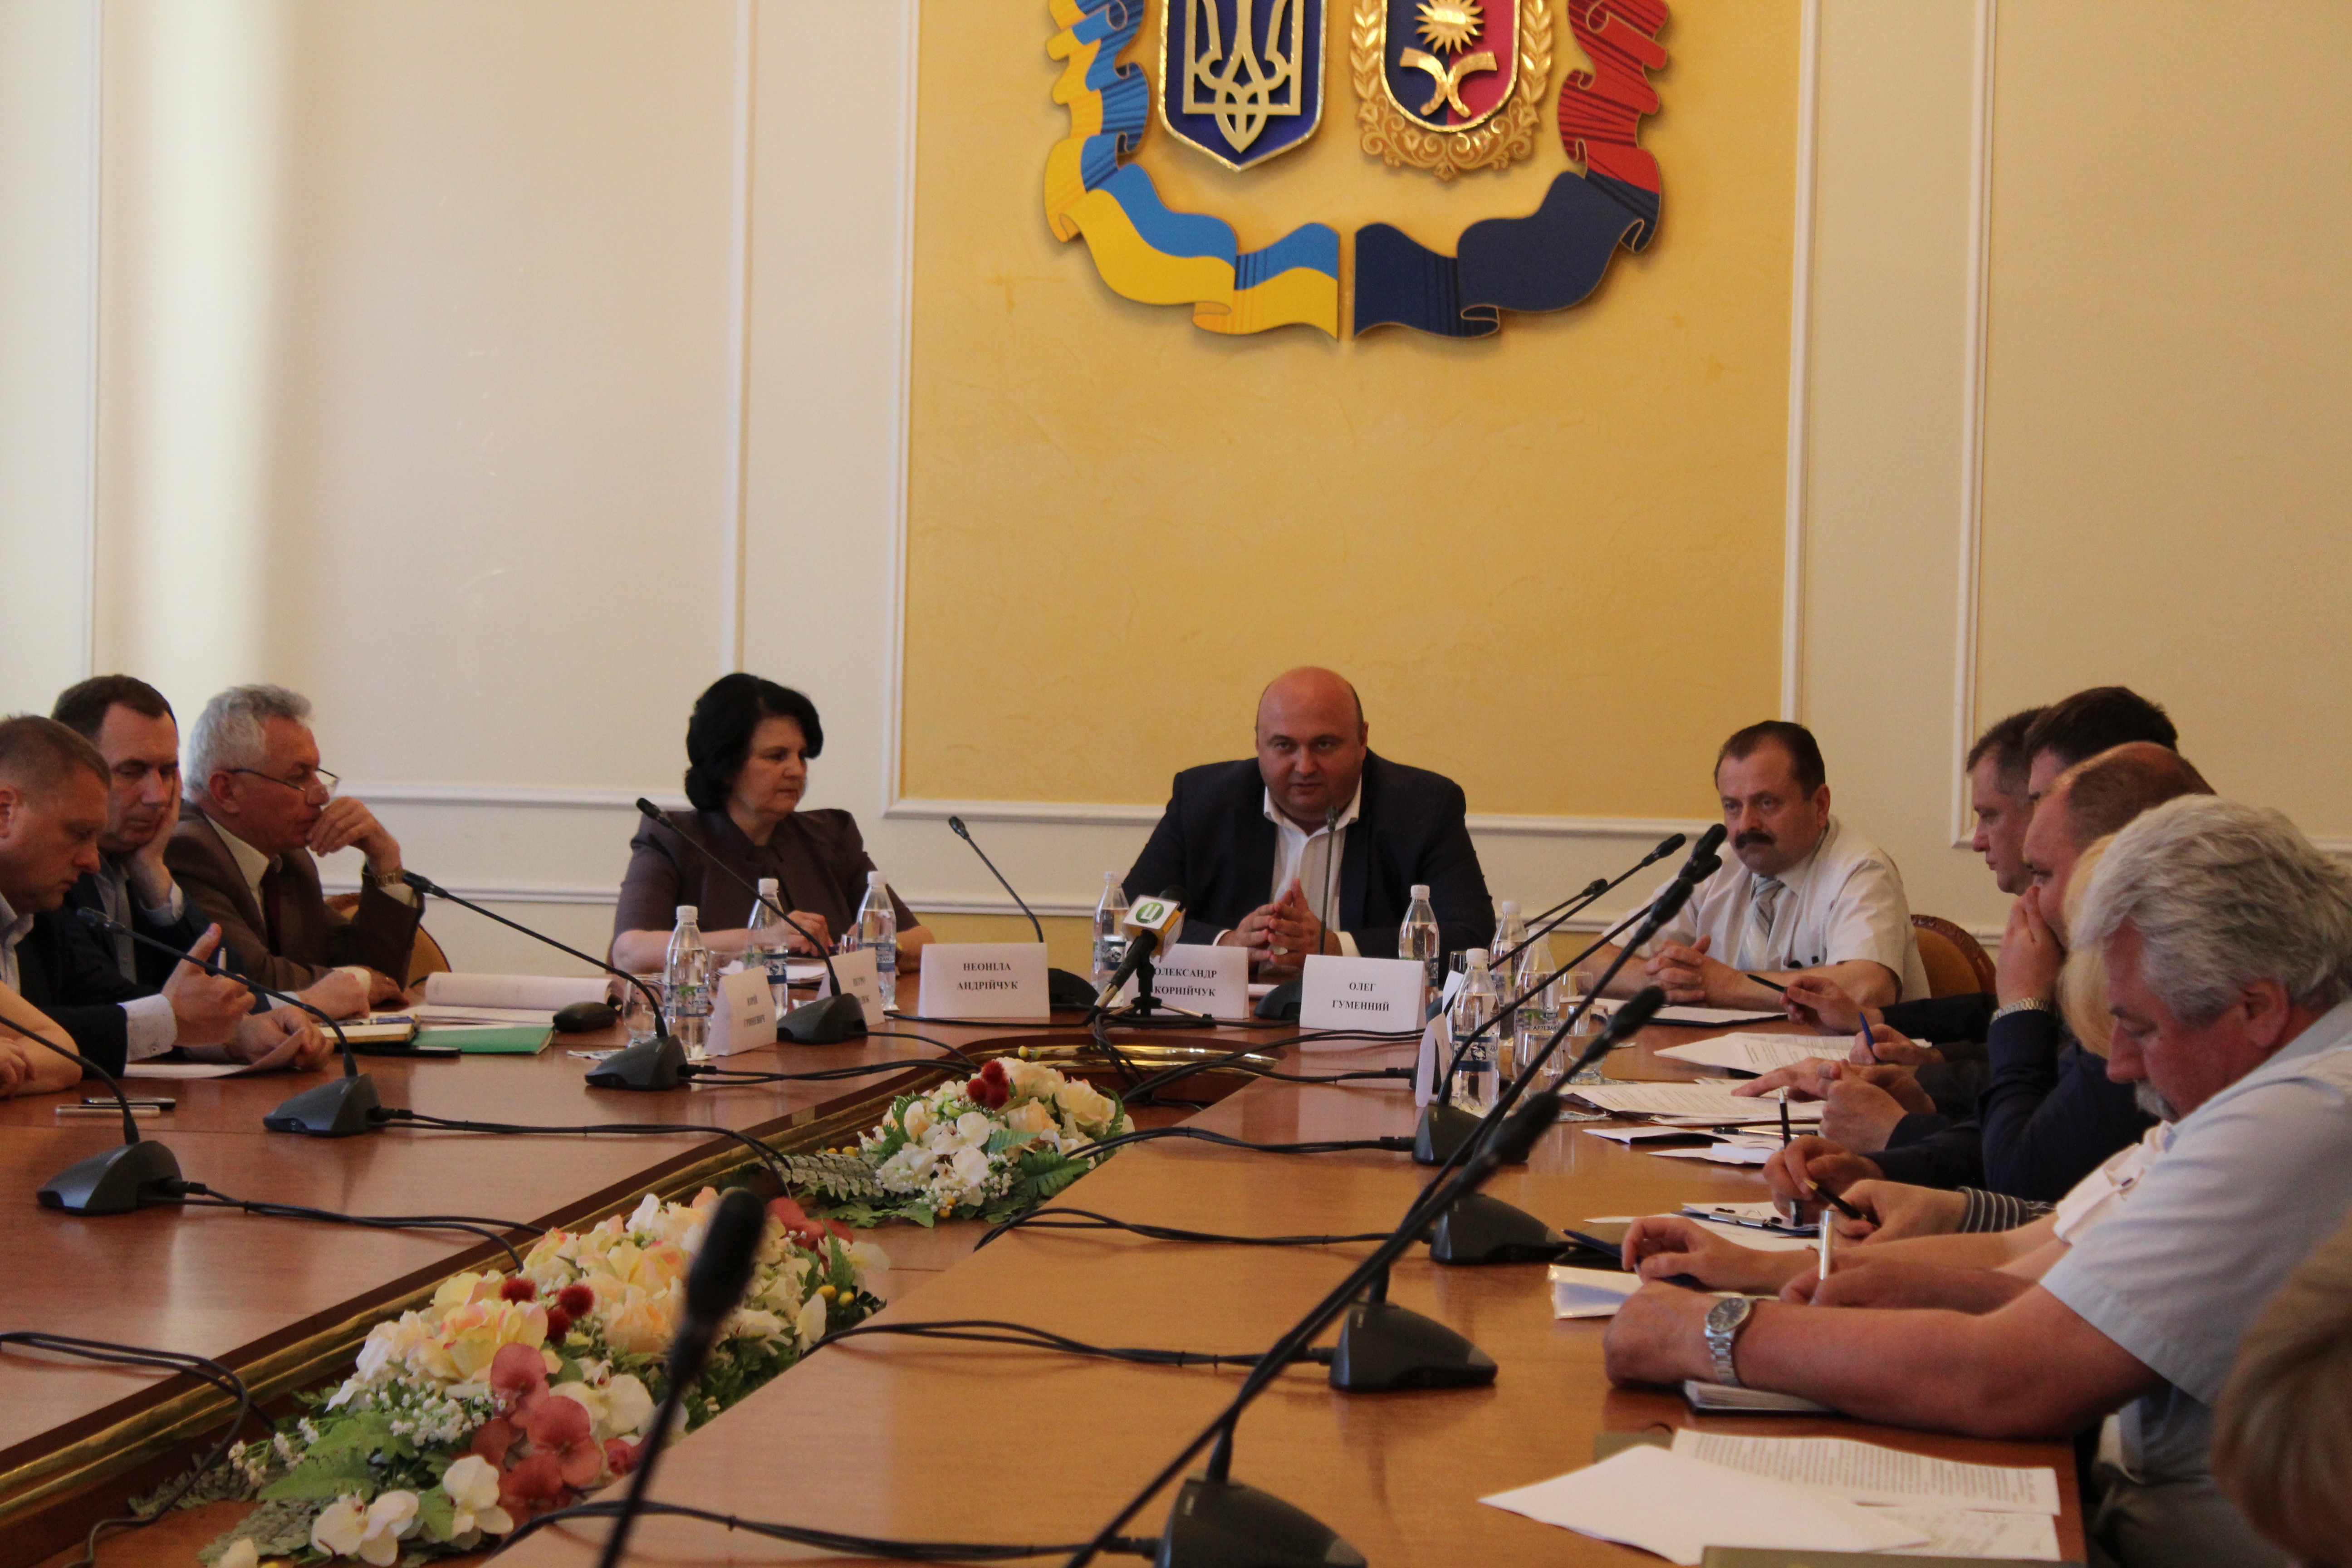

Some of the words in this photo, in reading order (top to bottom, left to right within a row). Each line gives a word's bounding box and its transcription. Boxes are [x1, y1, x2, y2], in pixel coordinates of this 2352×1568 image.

[963, 962, 1011, 971] НЕОНІЛА
[1155, 967, 1217, 979] ОЛЕКСАНДР
[957, 980, 1019, 991] АНДРІЙЧУК
[1154, 985, 1216, 997] КОРНІЙЧУК
[1349, 982, 1376, 992] ОЛЕГ
[1332, 1000, 1390, 1012] ГУМЕННИЙ
